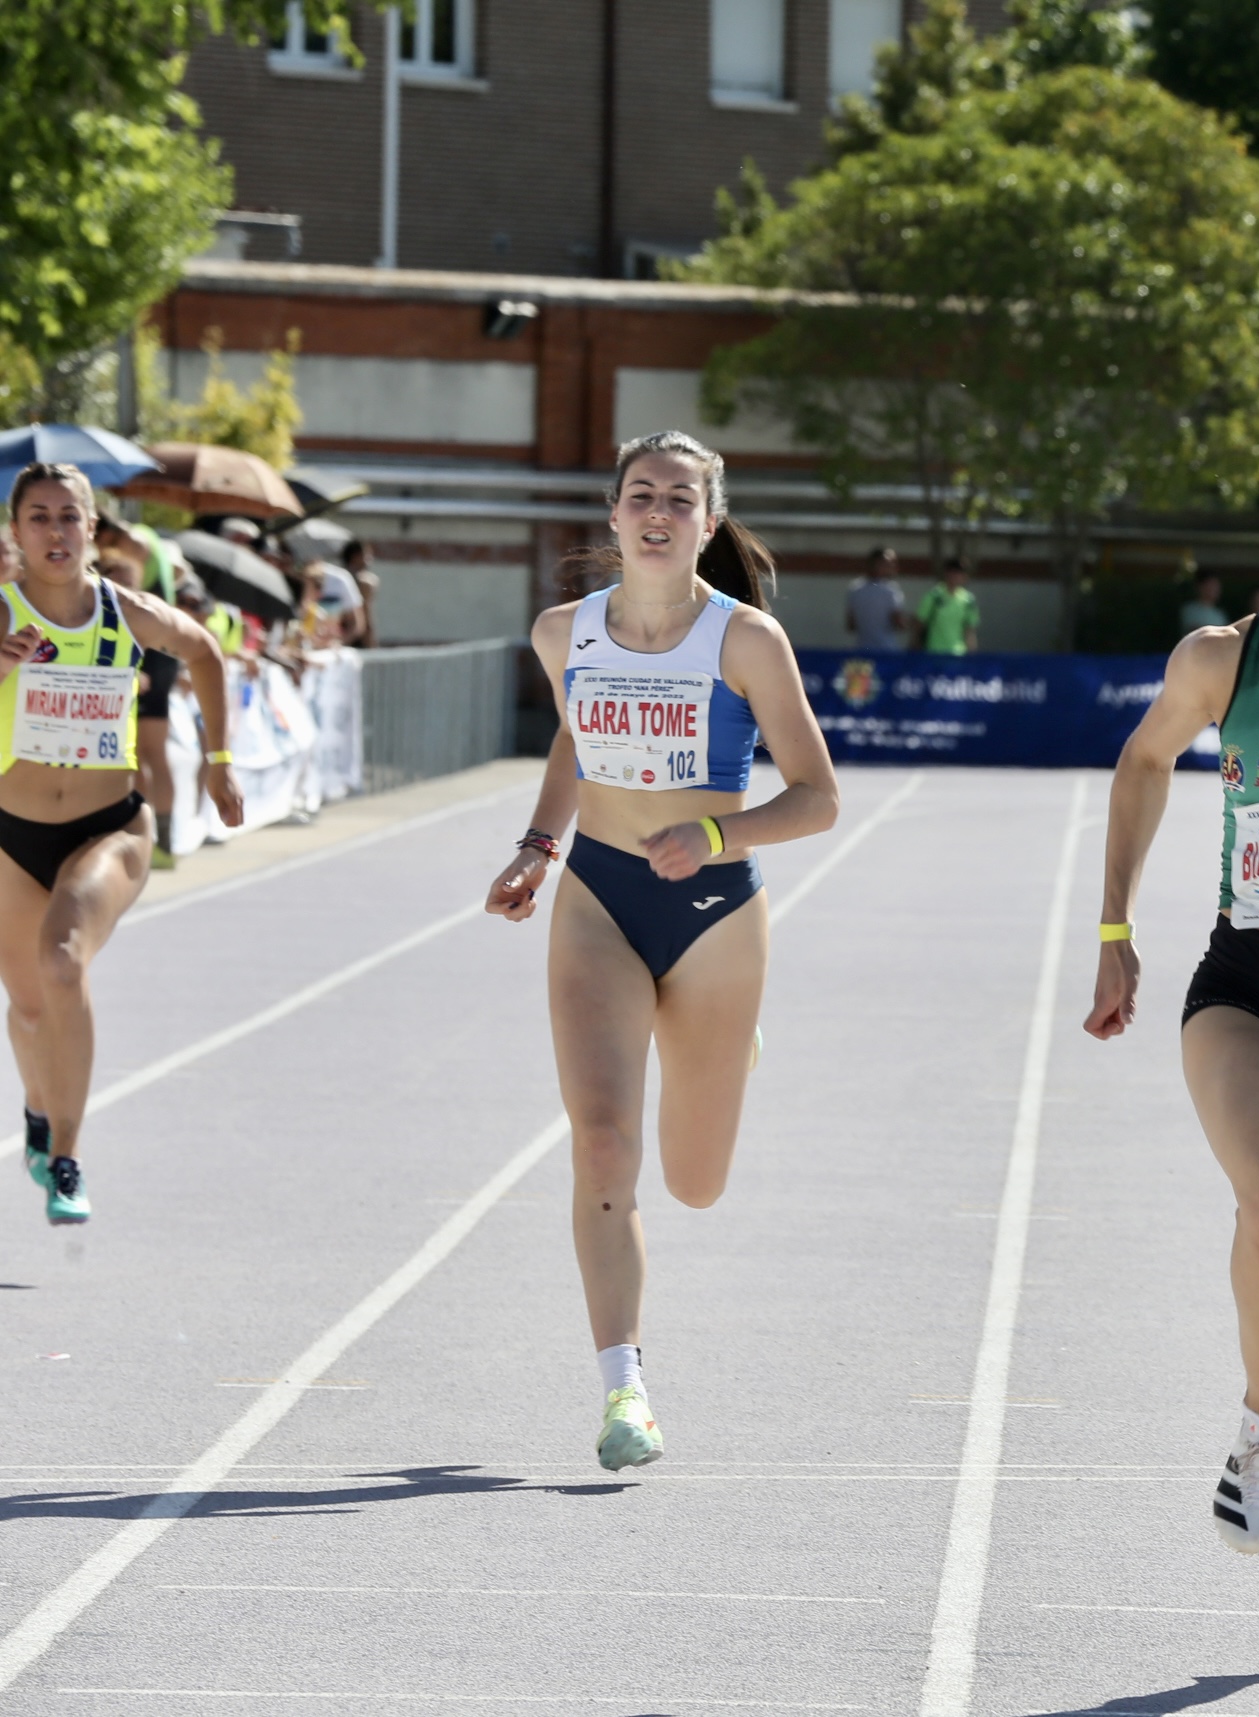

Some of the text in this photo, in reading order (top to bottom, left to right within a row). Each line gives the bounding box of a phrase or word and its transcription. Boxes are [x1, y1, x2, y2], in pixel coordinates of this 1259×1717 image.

[663, 679, 703, 687] VALLADOLID
[928, 675, 1047, 703] Valladolid
[25, 689, 124, 720] MIRIAM CARBALLO
[577, 700, 697, 737] LARA TOME
[98, 731, 118, 759] 69
[667, 750, 696, 781] 102
